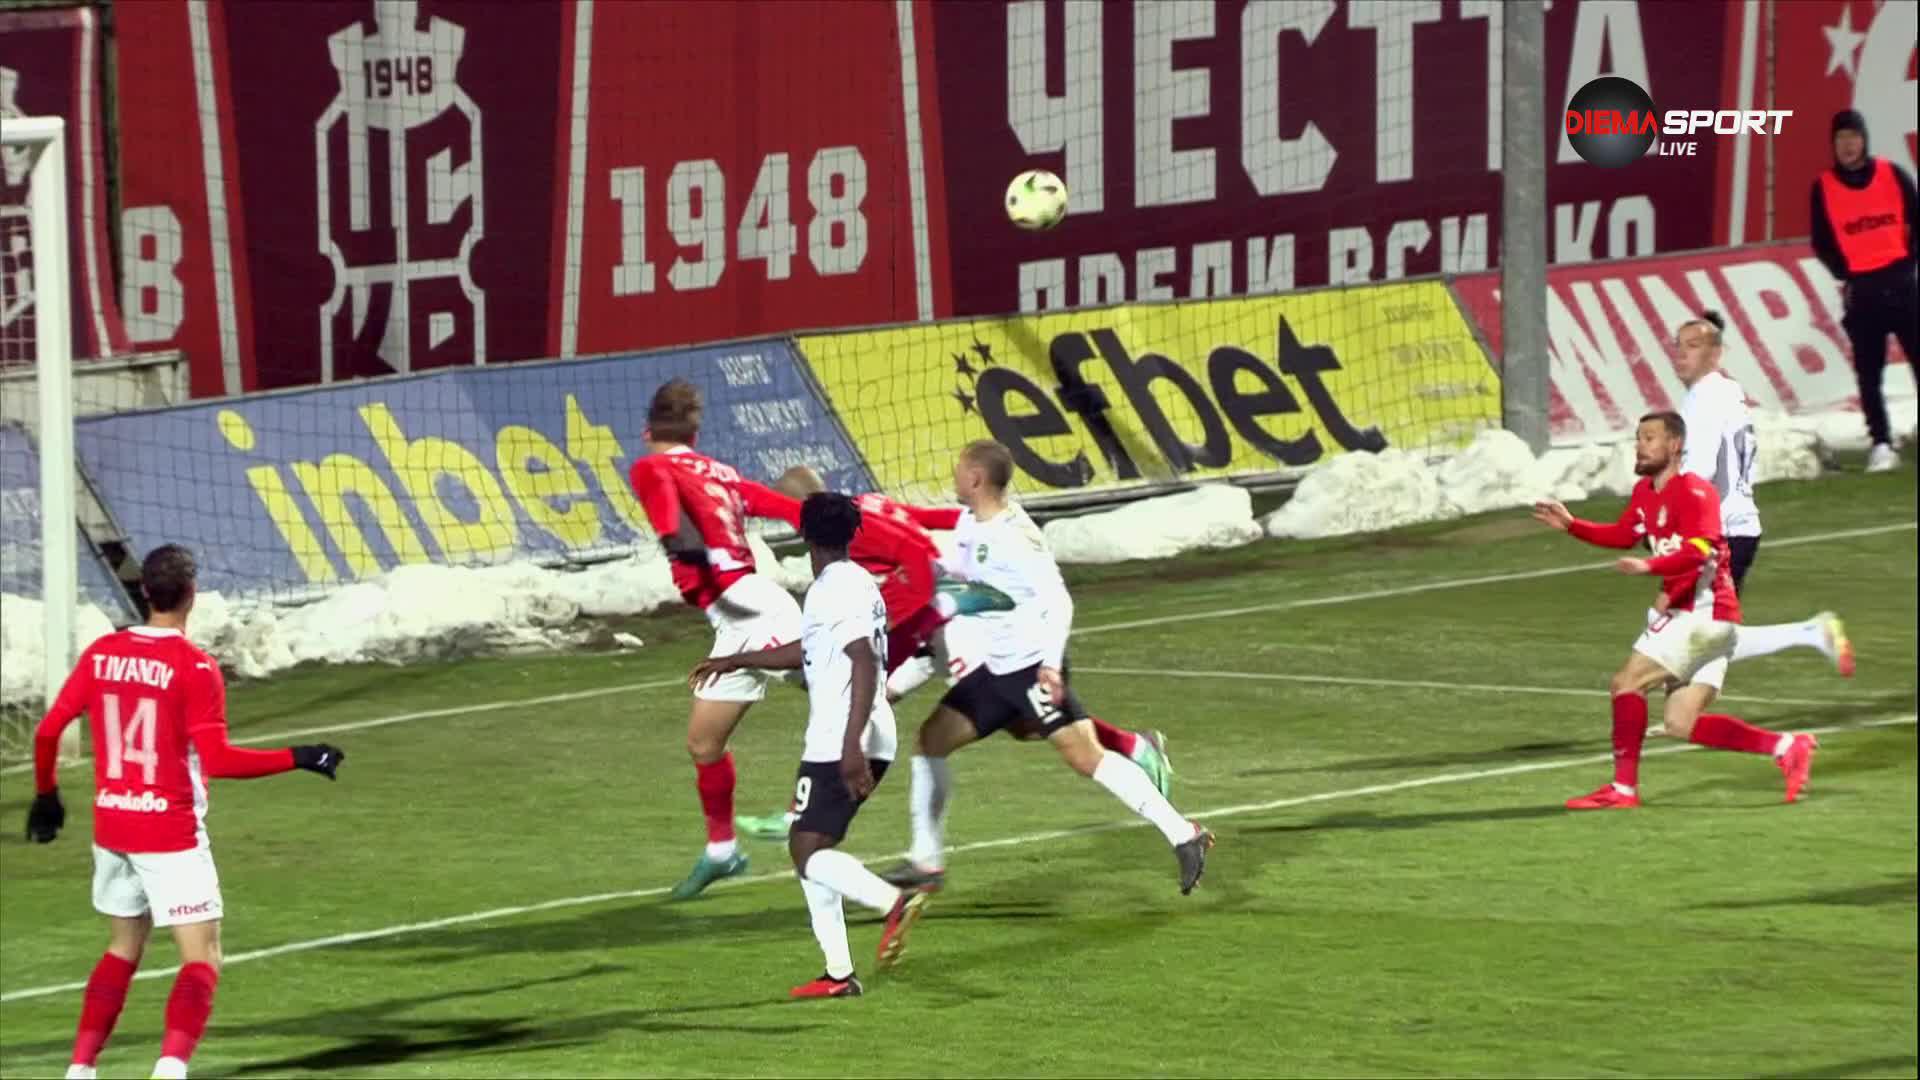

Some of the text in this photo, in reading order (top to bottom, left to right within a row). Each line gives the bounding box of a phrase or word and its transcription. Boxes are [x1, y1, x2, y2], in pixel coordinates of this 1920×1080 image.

[363, 57, 433, 97] 1948
[610, 146, 868, 296] 1948
[1329, 196, 1656, 288] ВСИКО
[976, 313, 1388, 488] efbet
[92, 653, 175, 690] T.IVANOV
[103, 693, 159, 785] 14
[794, 776, 812, 812] 9
[168, 901, 210, 917] efbet
